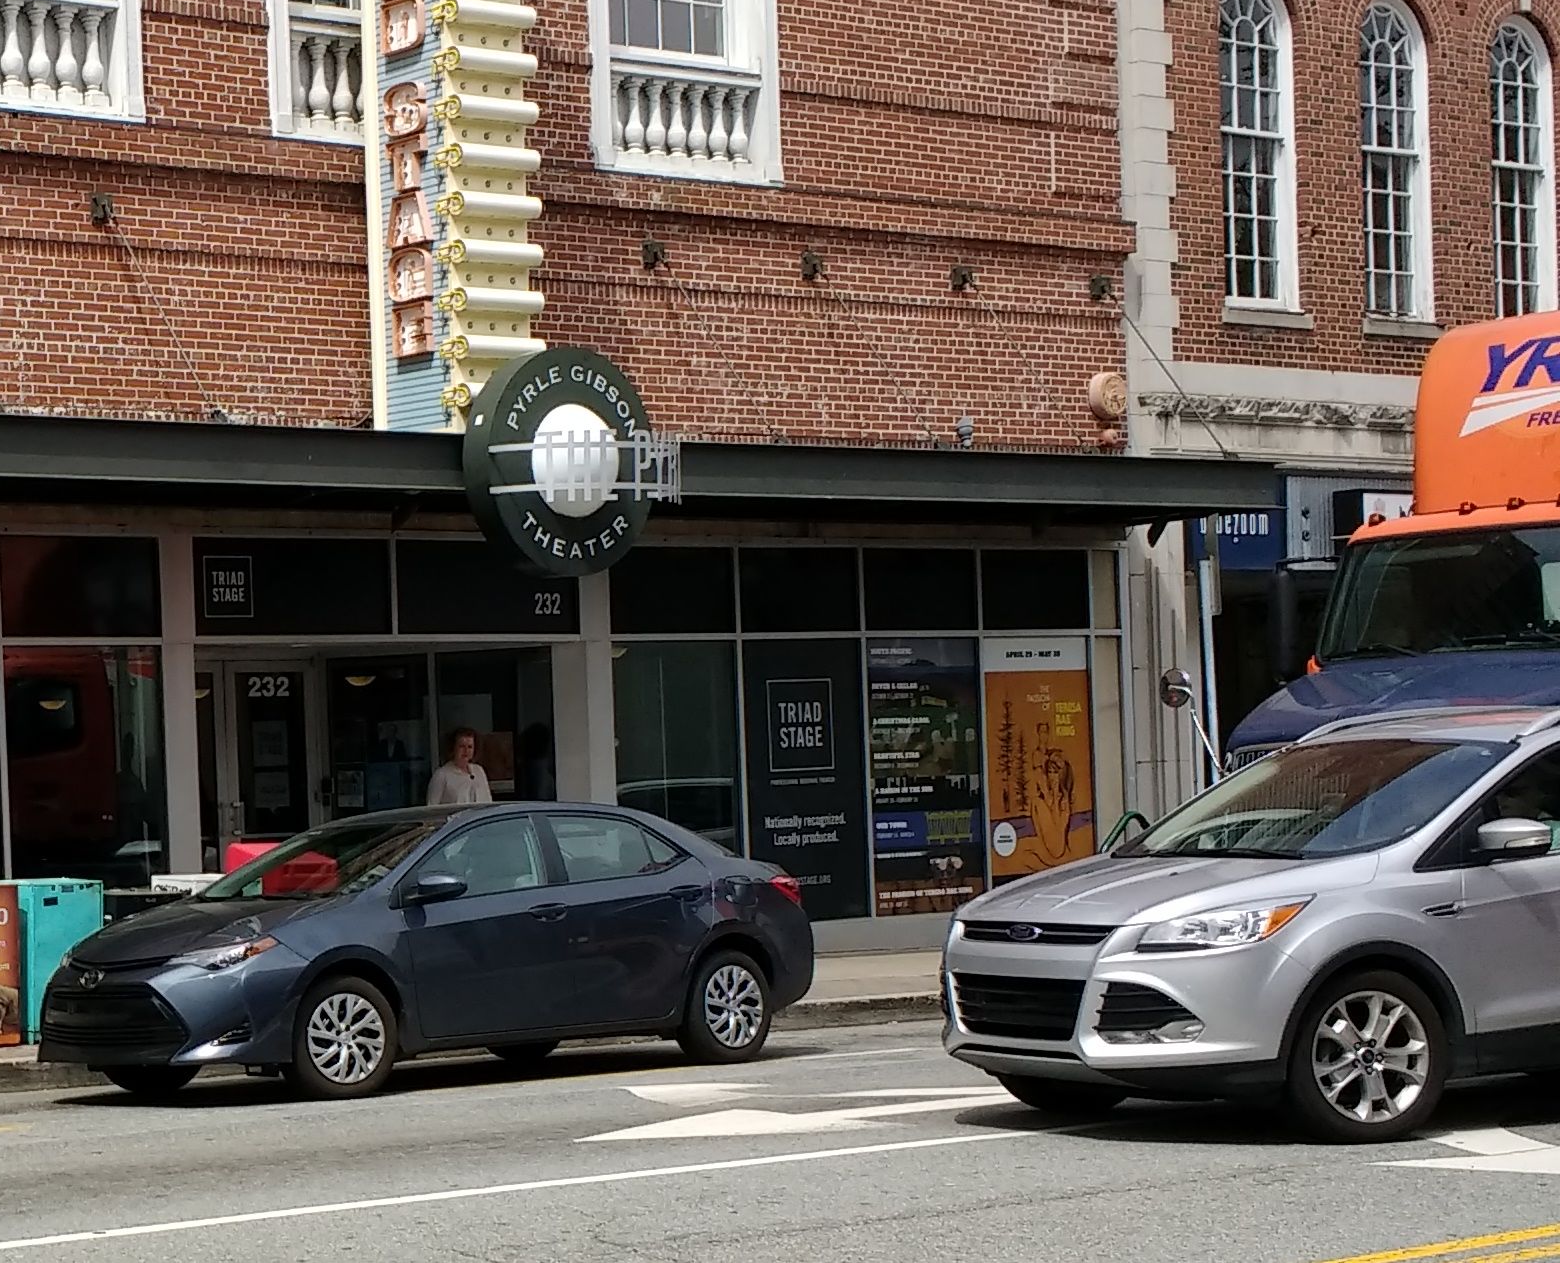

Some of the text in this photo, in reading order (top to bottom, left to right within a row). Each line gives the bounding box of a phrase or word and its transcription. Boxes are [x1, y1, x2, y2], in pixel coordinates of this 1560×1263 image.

[384, 81, 433, 360] STAGE
[507, 365, 639, 439] PYRLE GIBSON
[538, 429, 618, 502] THE
[521, 514, 630, 559] THEATER
[212, 571, 245, 586] TRIAD
[212, 588, 245, 602] STAGE
[535, 593, 561, 615] 232
[248, 676, 290, 697] 232
[778, 702, 823, 723] TRIAD
[780, 726, 824, 748] STAGE
[774, 832, 801, 847] Locally
